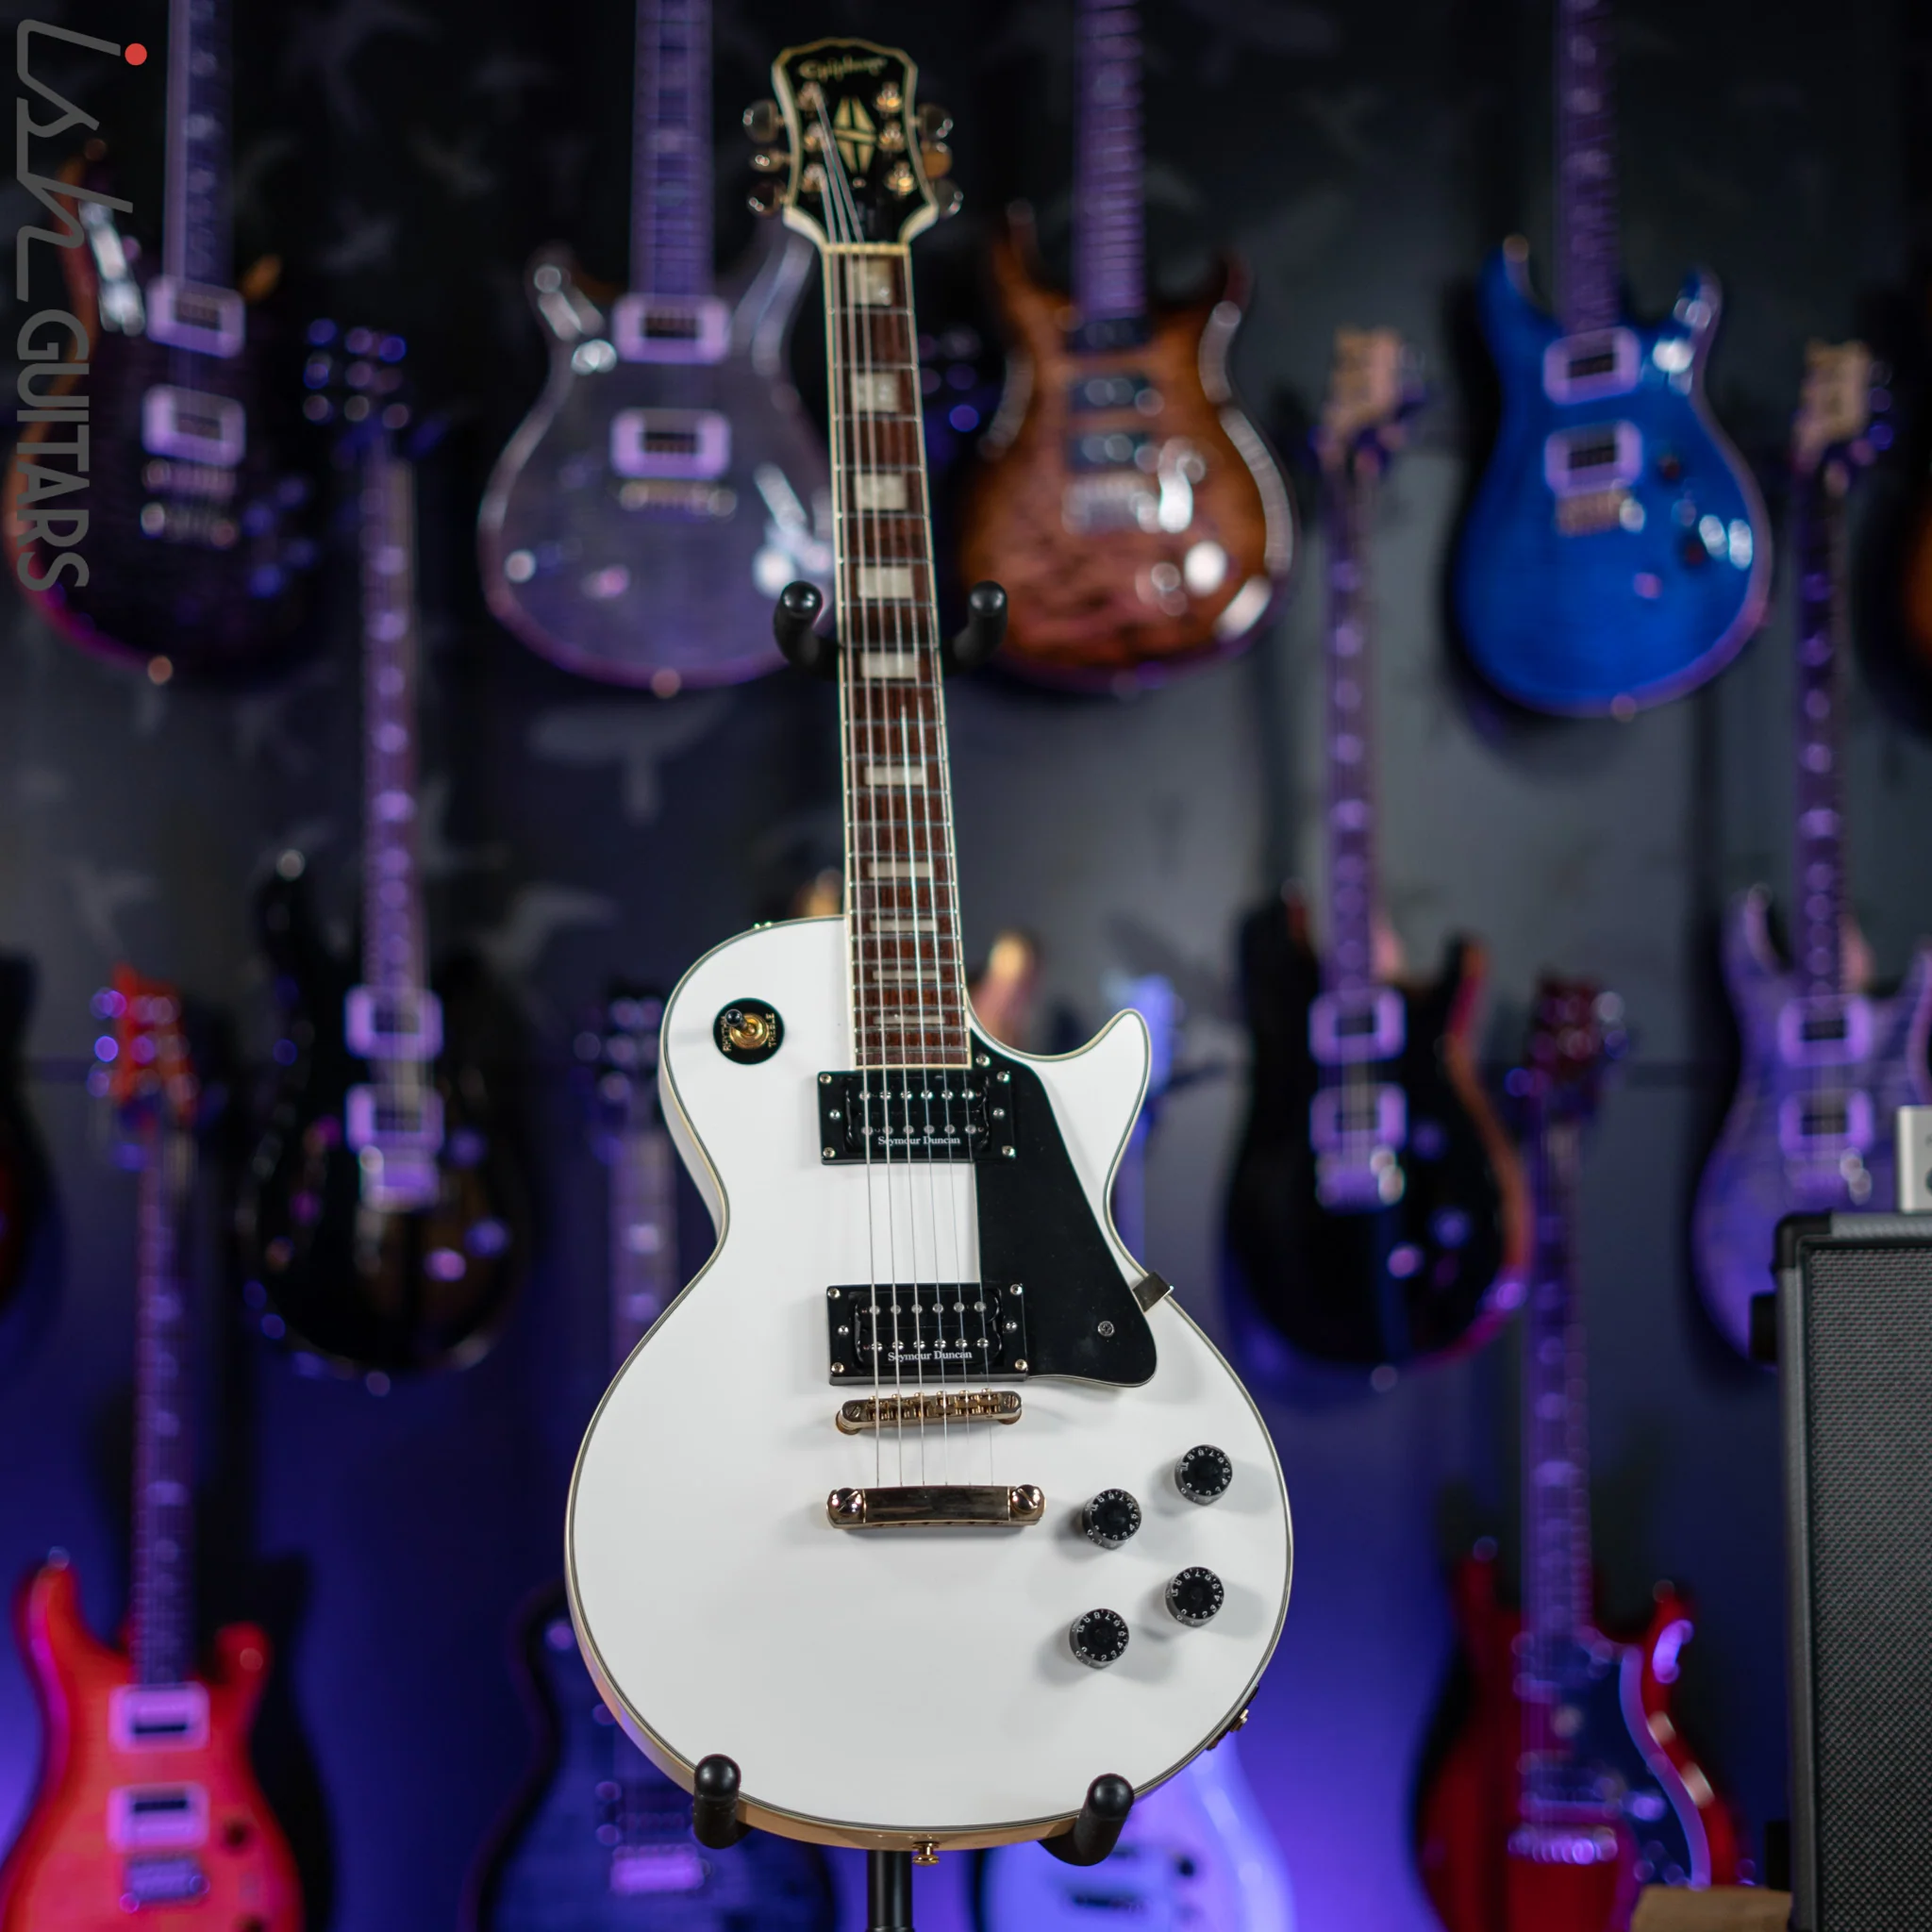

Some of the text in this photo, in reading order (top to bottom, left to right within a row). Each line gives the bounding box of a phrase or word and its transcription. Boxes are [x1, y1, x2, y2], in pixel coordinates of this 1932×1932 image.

[765, 1012, 776, 1047] TREBLE
[877, 1135, 960, 1146] Seymour Duncan
[888, 1350, 972, 1362] Seymour Duncan
